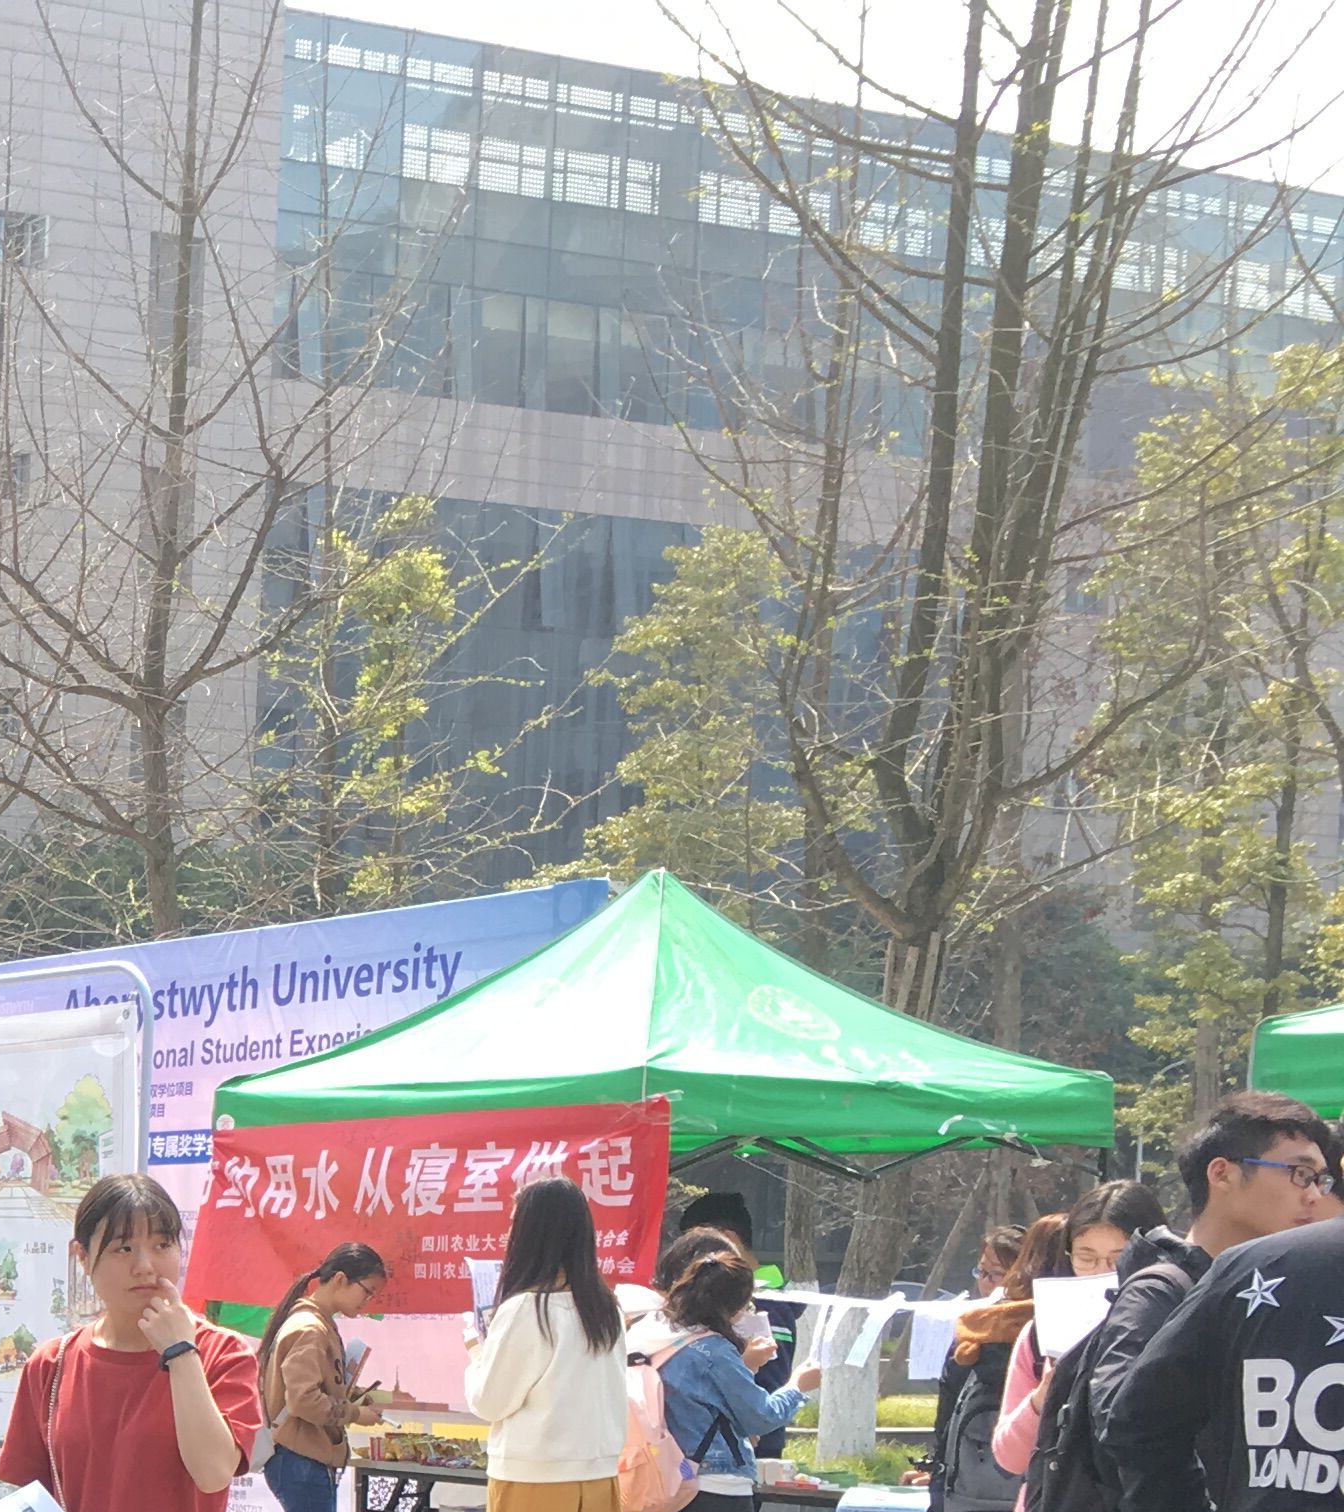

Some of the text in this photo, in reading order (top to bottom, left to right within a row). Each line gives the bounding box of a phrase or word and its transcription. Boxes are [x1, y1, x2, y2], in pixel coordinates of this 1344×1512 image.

[273, 943, 463, 1009] University
[152, 1040, 194, 1069] onal
[201, 1031, 282, 1064] Student
[1248, 1448, 1344, 1495] LOND
